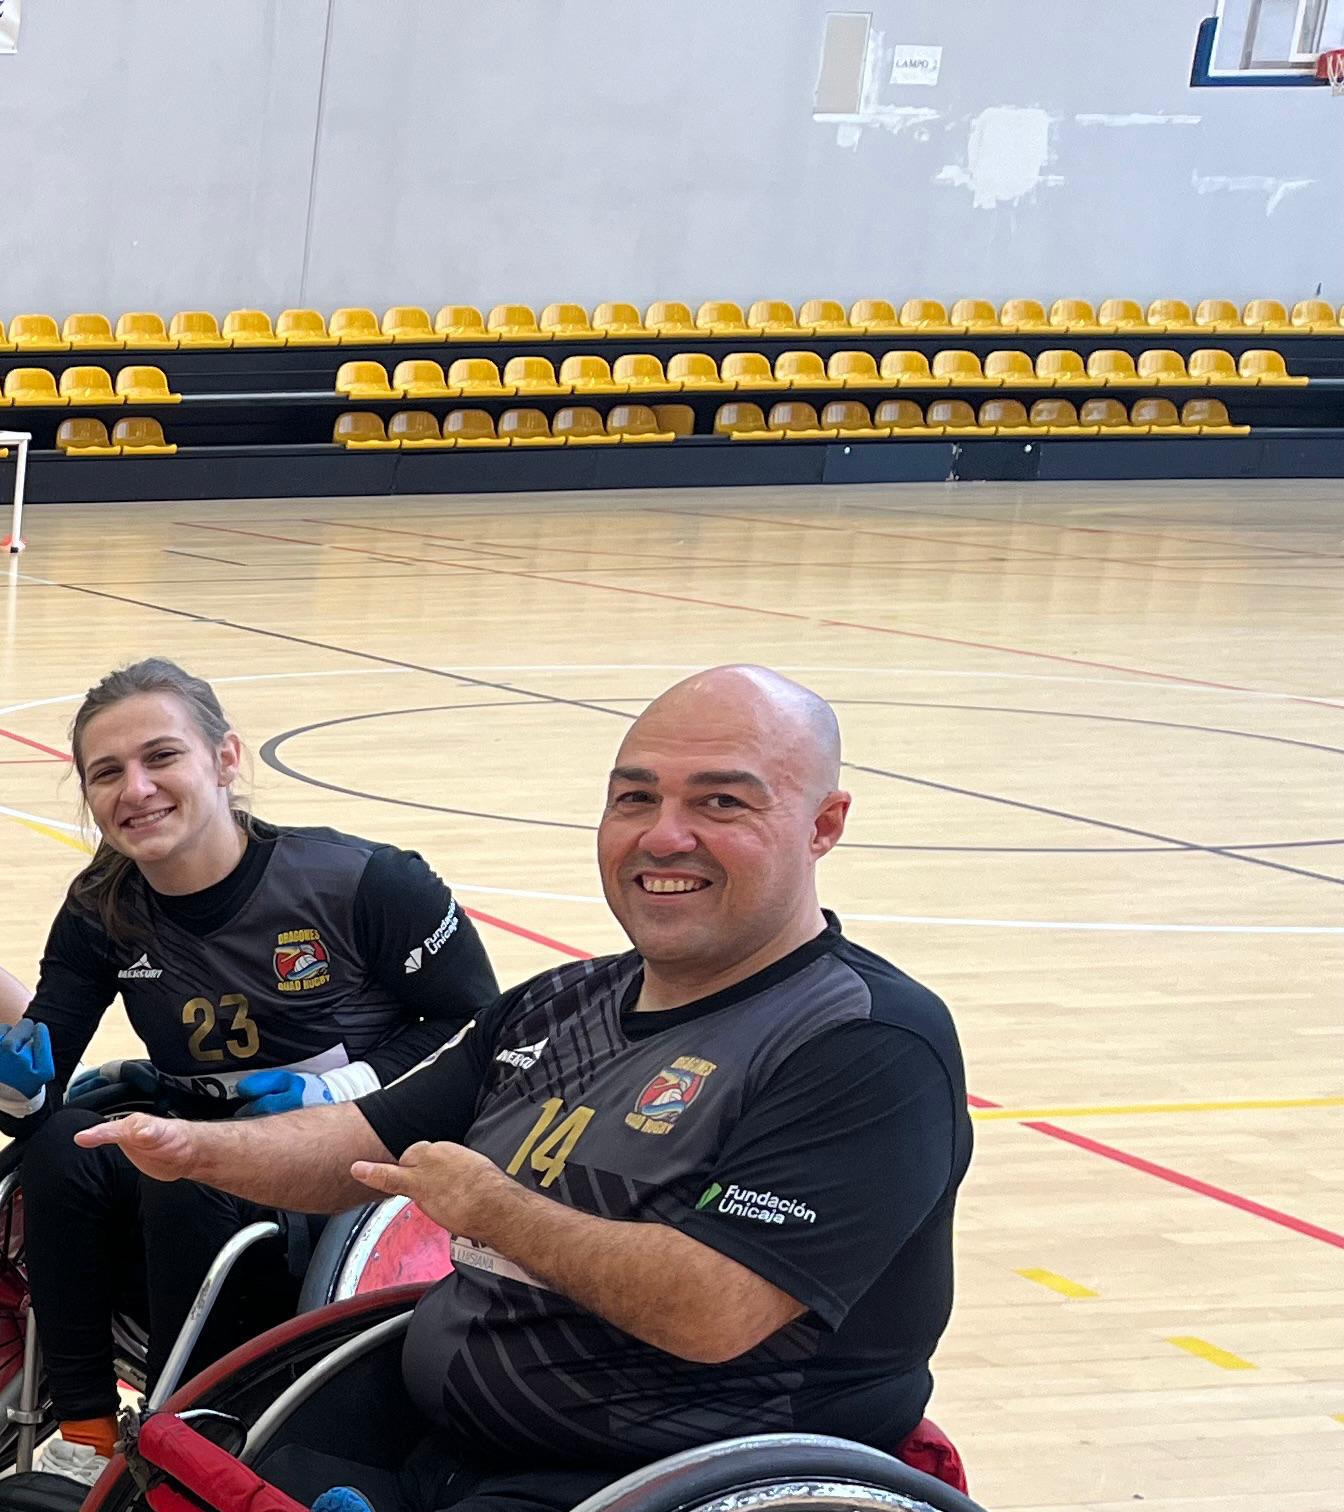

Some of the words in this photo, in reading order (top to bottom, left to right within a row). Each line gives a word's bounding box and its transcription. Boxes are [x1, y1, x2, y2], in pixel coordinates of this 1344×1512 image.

[277, 928, 321, 945] DRAGONES
[277, 979, 302, 992] QUAD
[303, 974, 331, 991] RUGBY
[182, 993, 260, 1061] 23
[506, 1097, 596, 1188] 14
[718, 1198, 786, 1225] Unicaja
[724, 1184, 817, 1224] Fundación
